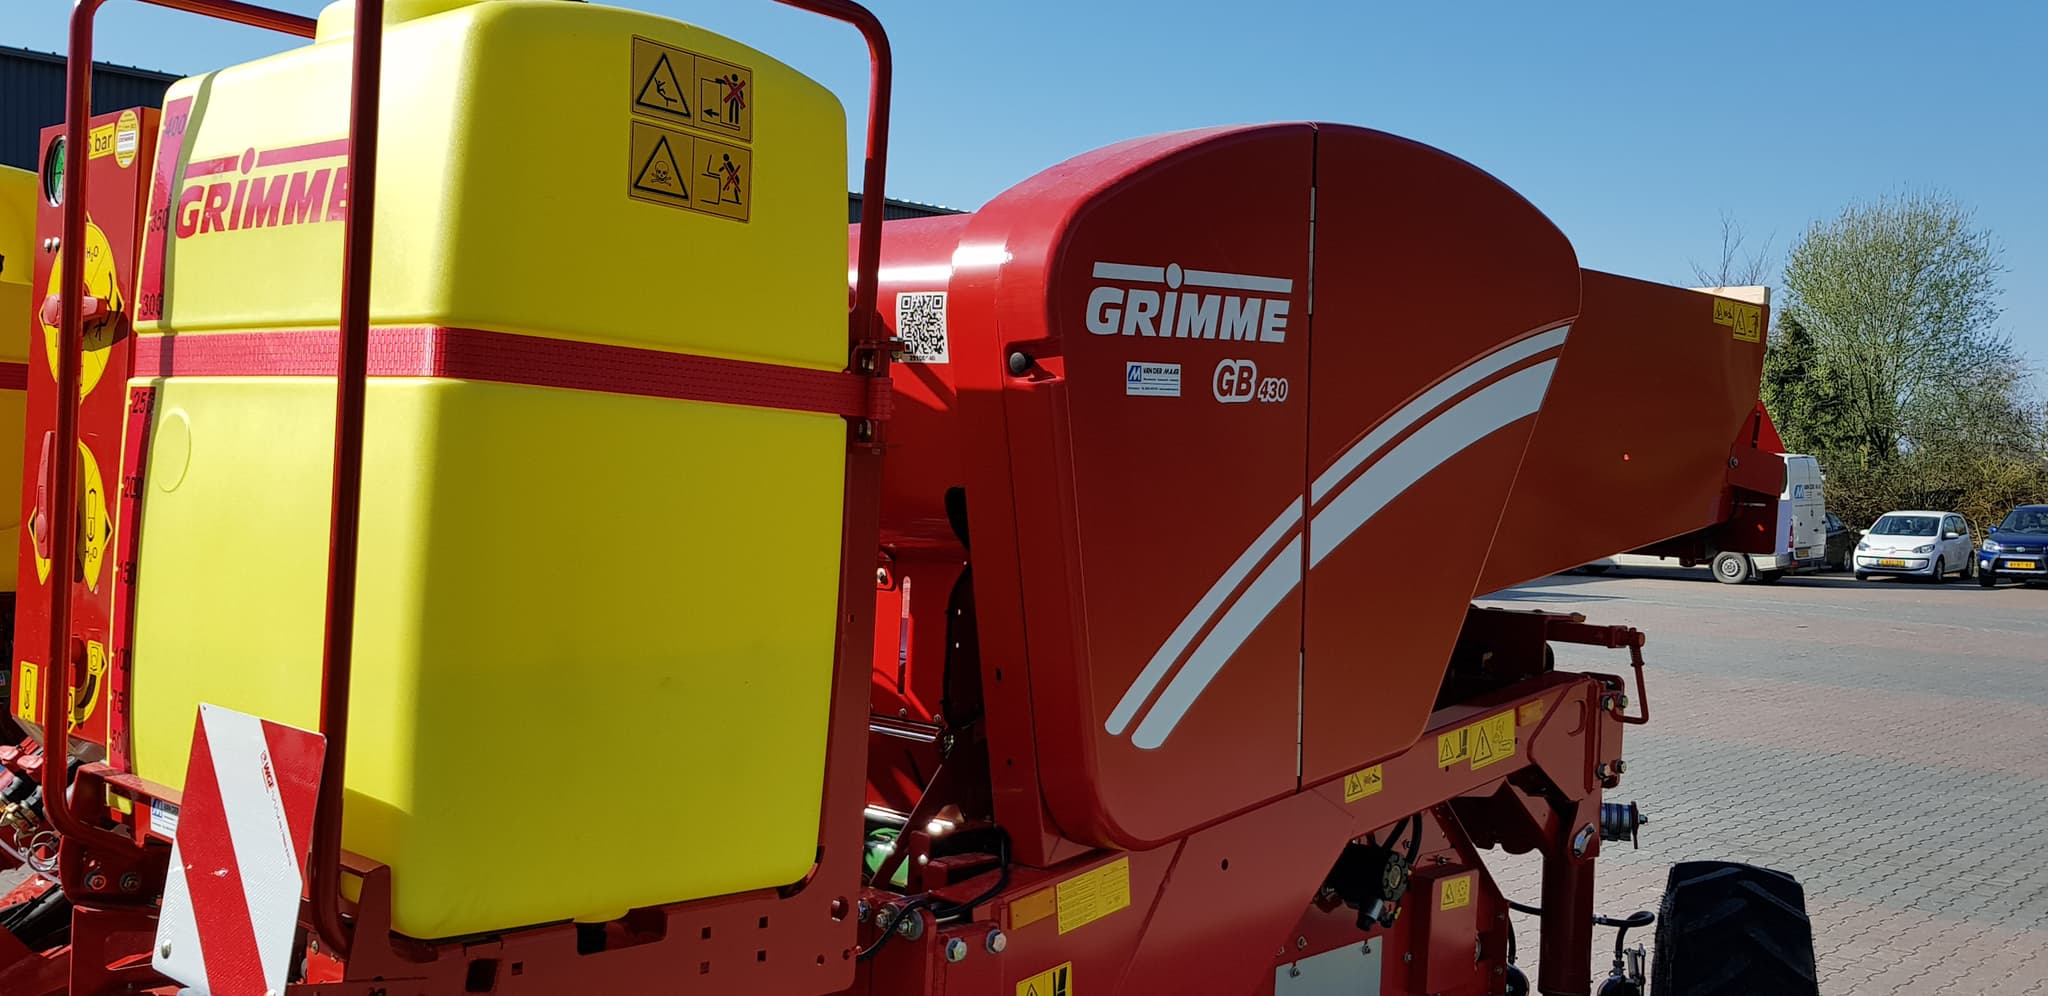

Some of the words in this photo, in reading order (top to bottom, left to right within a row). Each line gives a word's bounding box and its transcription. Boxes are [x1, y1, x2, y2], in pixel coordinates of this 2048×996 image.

[165, 114, 187, 137] 400
[95, 134, 113, 152] bar
[150, 208, 168, 232] 350
[141, 293, 164, 316] 300
[1085, 263, 1290, 344] GRIMME
[1215, 362, 1255, 399] GB
[1258, 379, 1288, 401] 430
[132, 391, 155, 415] 250
[124, 476, 144, 499] 200
[118, 561, 137, 586] 150
[112, 689, 124, 714] 75
